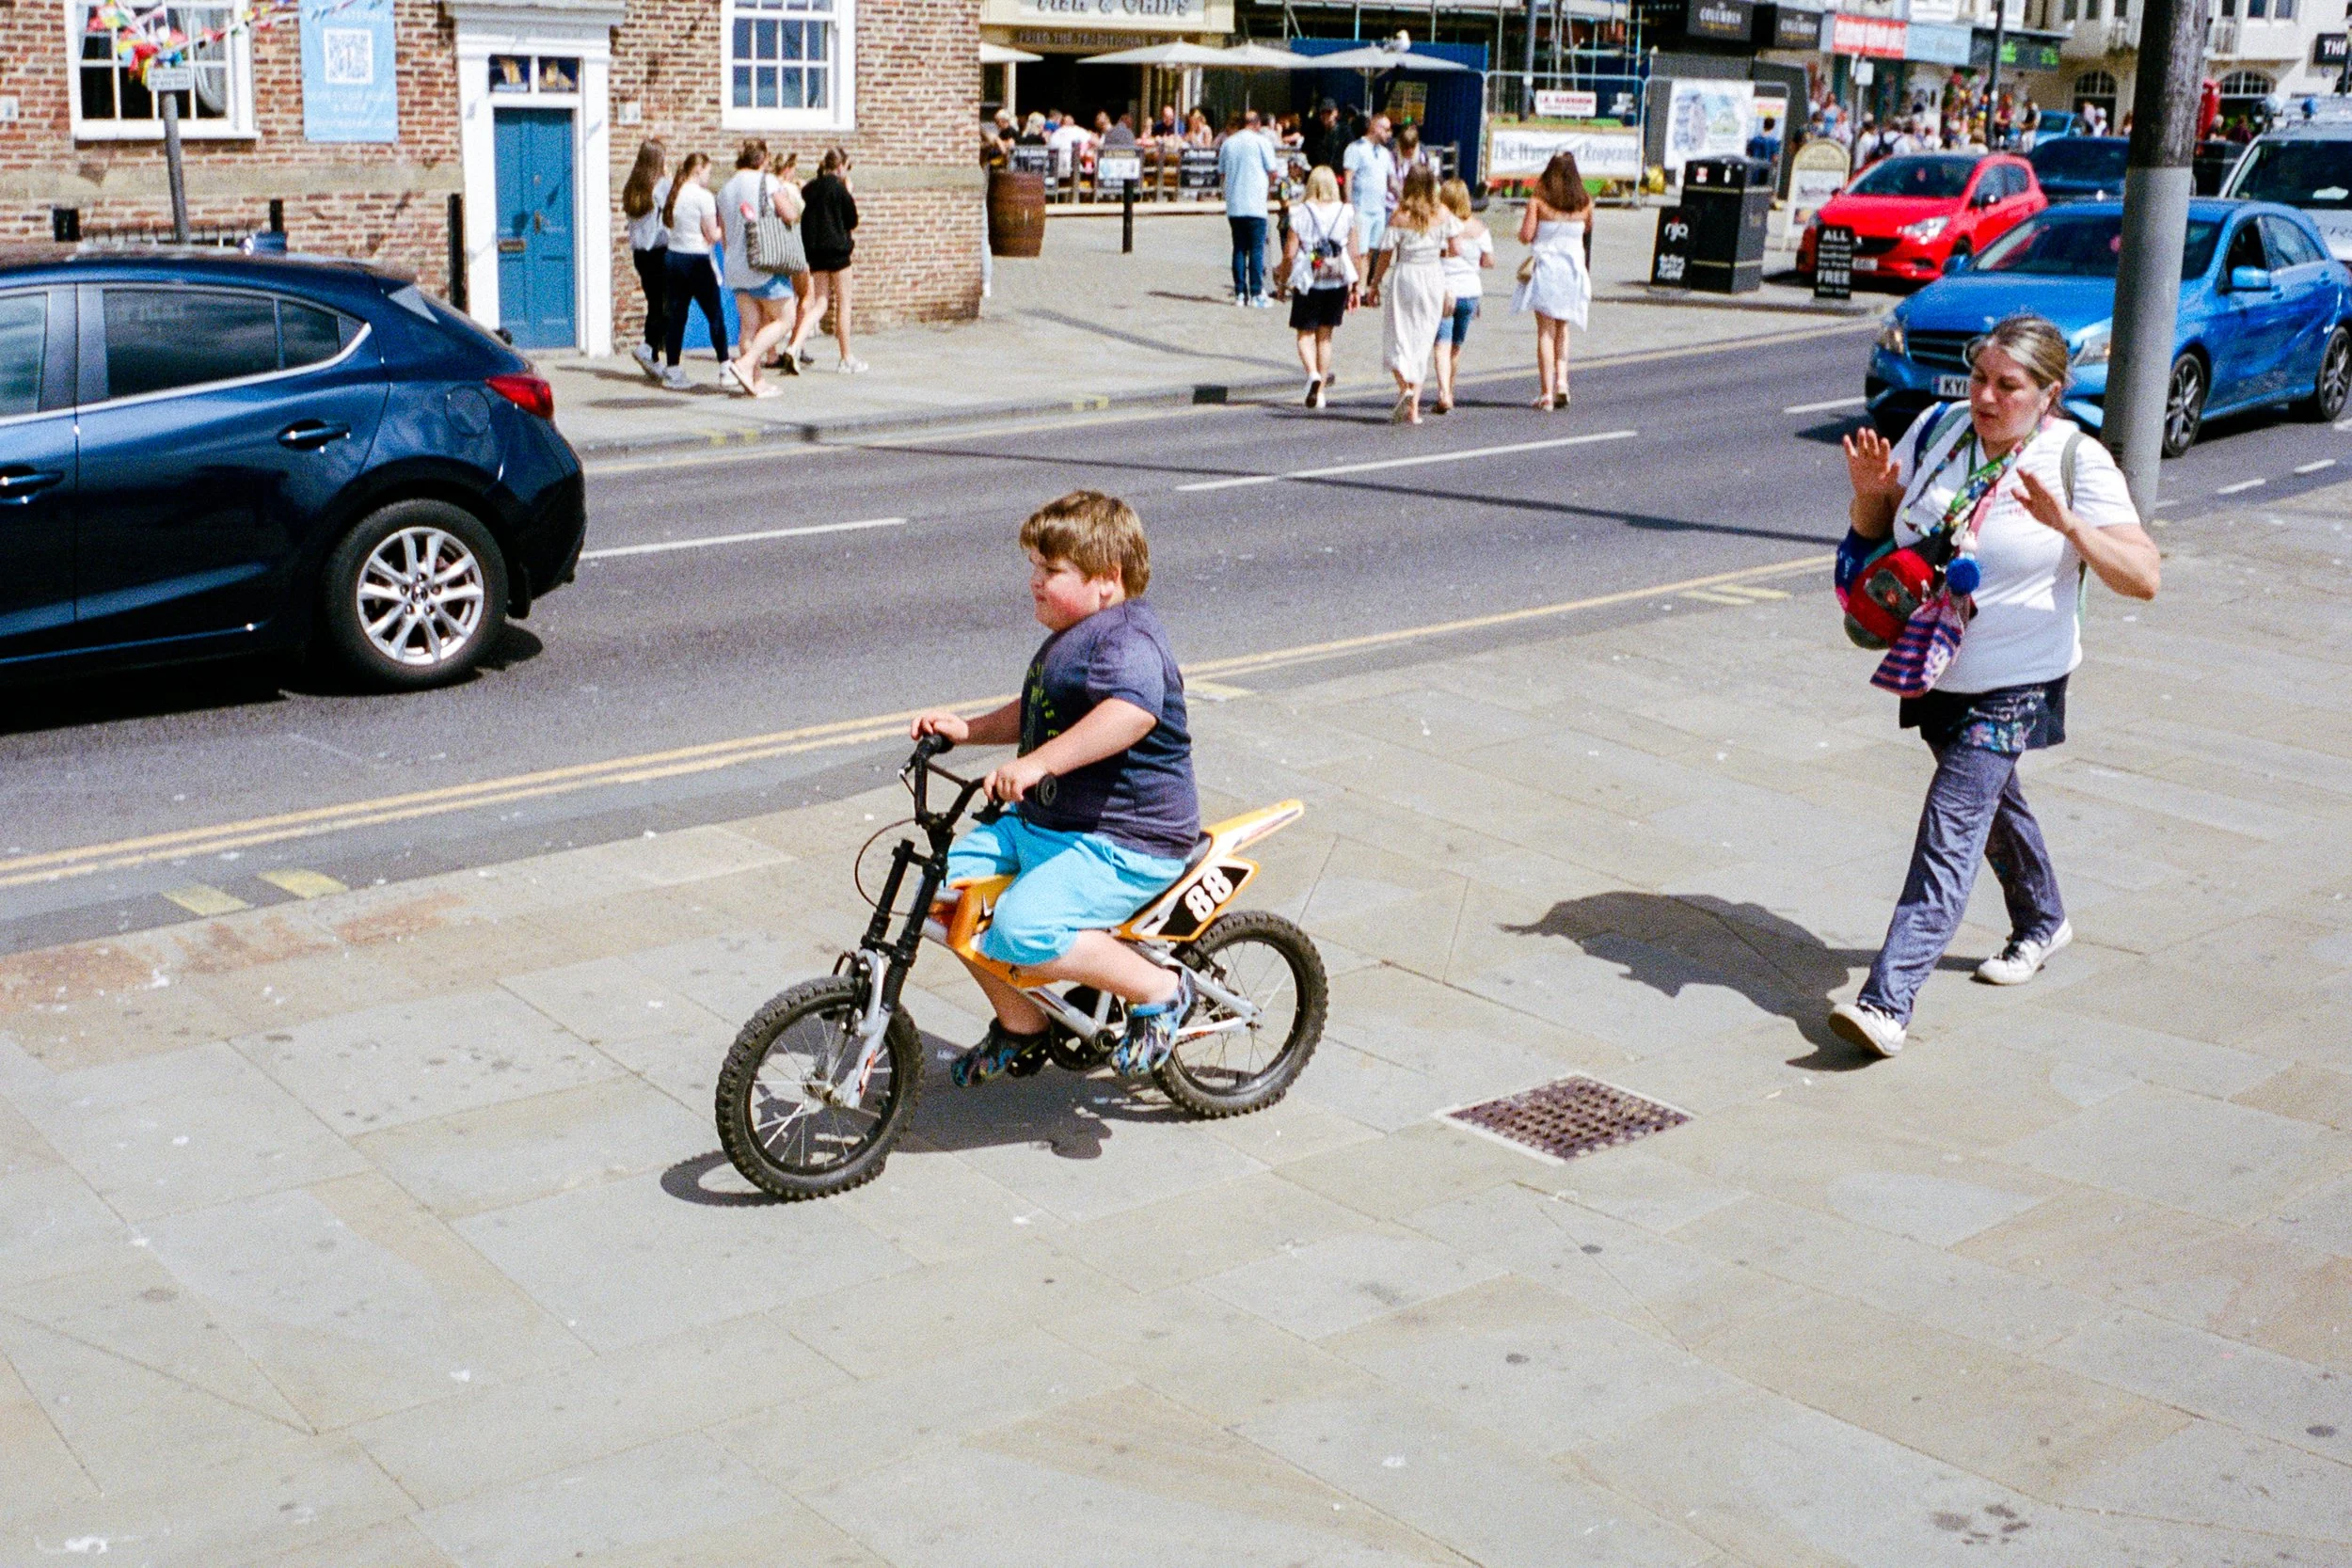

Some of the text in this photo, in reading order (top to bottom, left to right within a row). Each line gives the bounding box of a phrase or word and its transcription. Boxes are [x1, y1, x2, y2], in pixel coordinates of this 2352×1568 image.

[1822, 230, 1850, 243] ALL
[1817, 269, 1851, 285] FREE
[1184, 866, 1234, 924] 88
